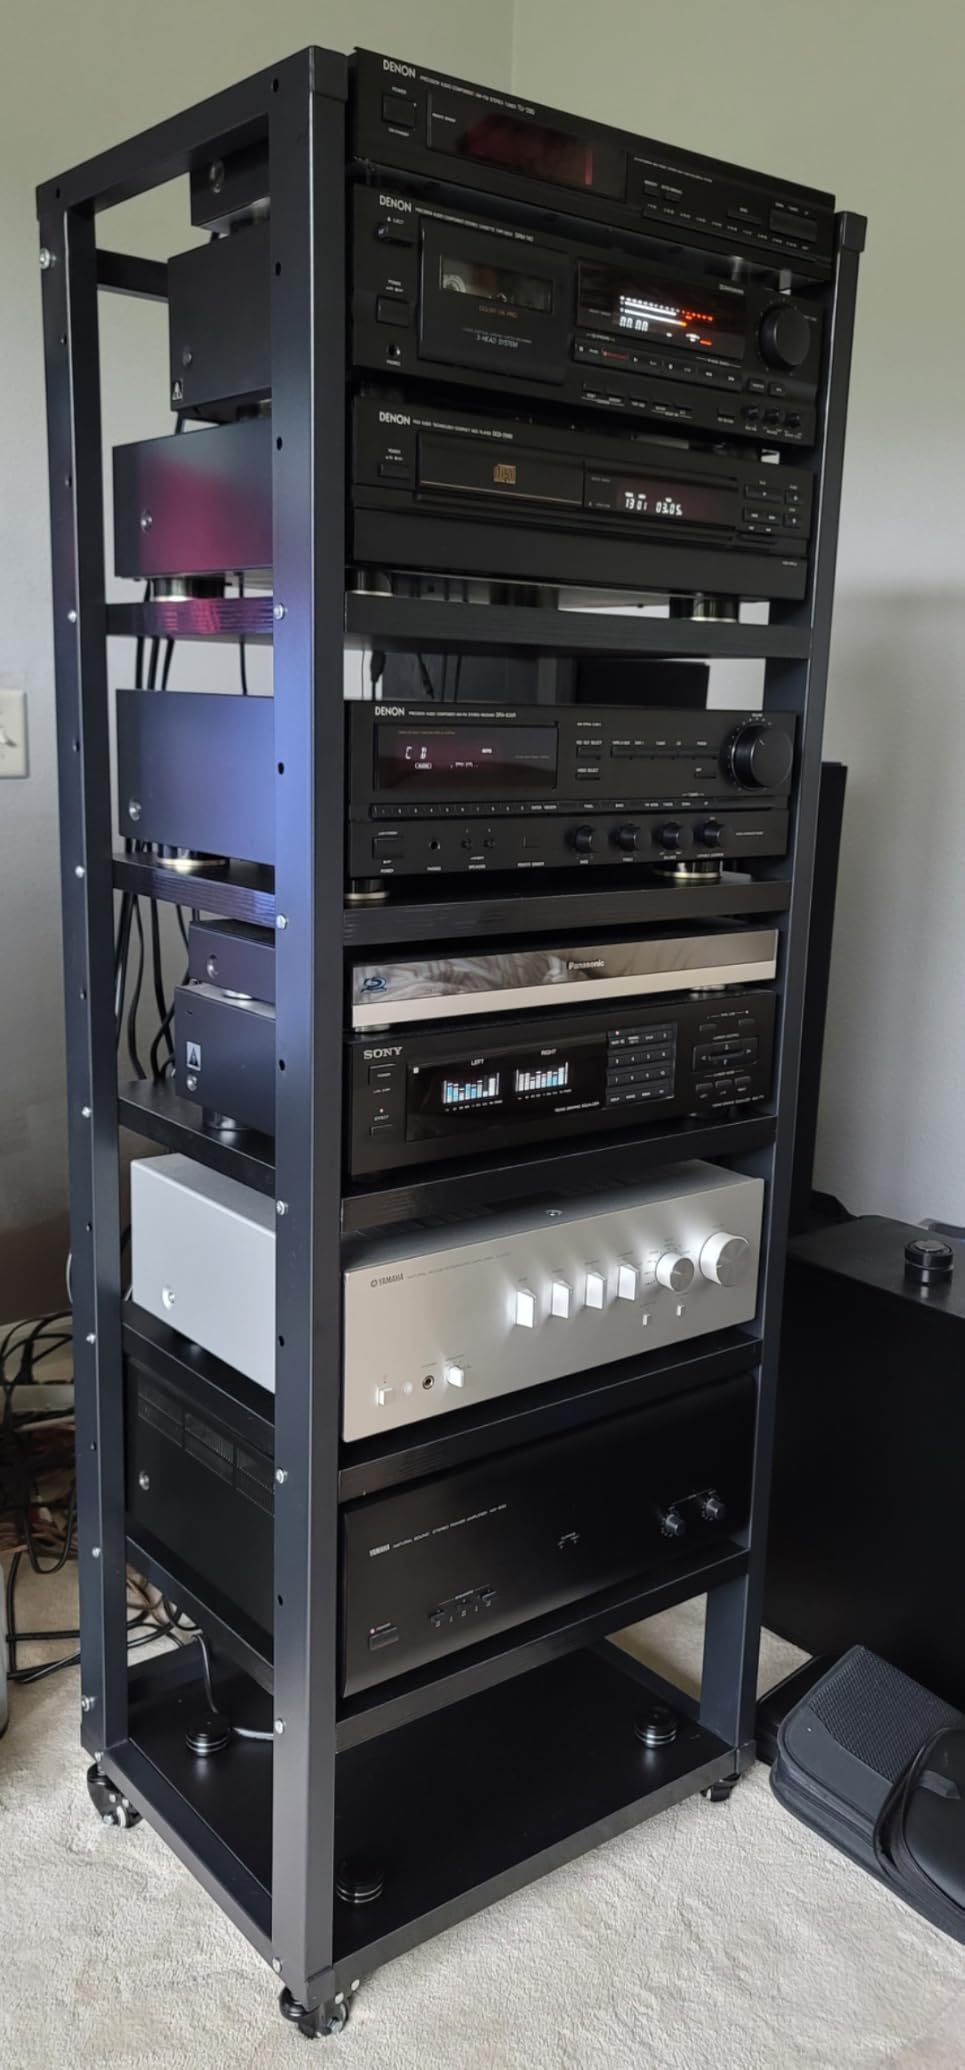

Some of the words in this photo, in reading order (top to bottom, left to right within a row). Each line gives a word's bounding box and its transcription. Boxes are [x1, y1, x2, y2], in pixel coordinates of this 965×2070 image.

[383, 59, 416, 79] DENON
[379, 195, 412, 213] DENON
[379, 411, 411, 426] DENON
[375, 706, 405, 717] DENON
[568, 959, 605, 971] Panasonic
[363, 1046, 403, 1060] SONY
[471, 1058, 485, 1067] LEFT
[378, 1272, 404, 1288] YAMAHA
